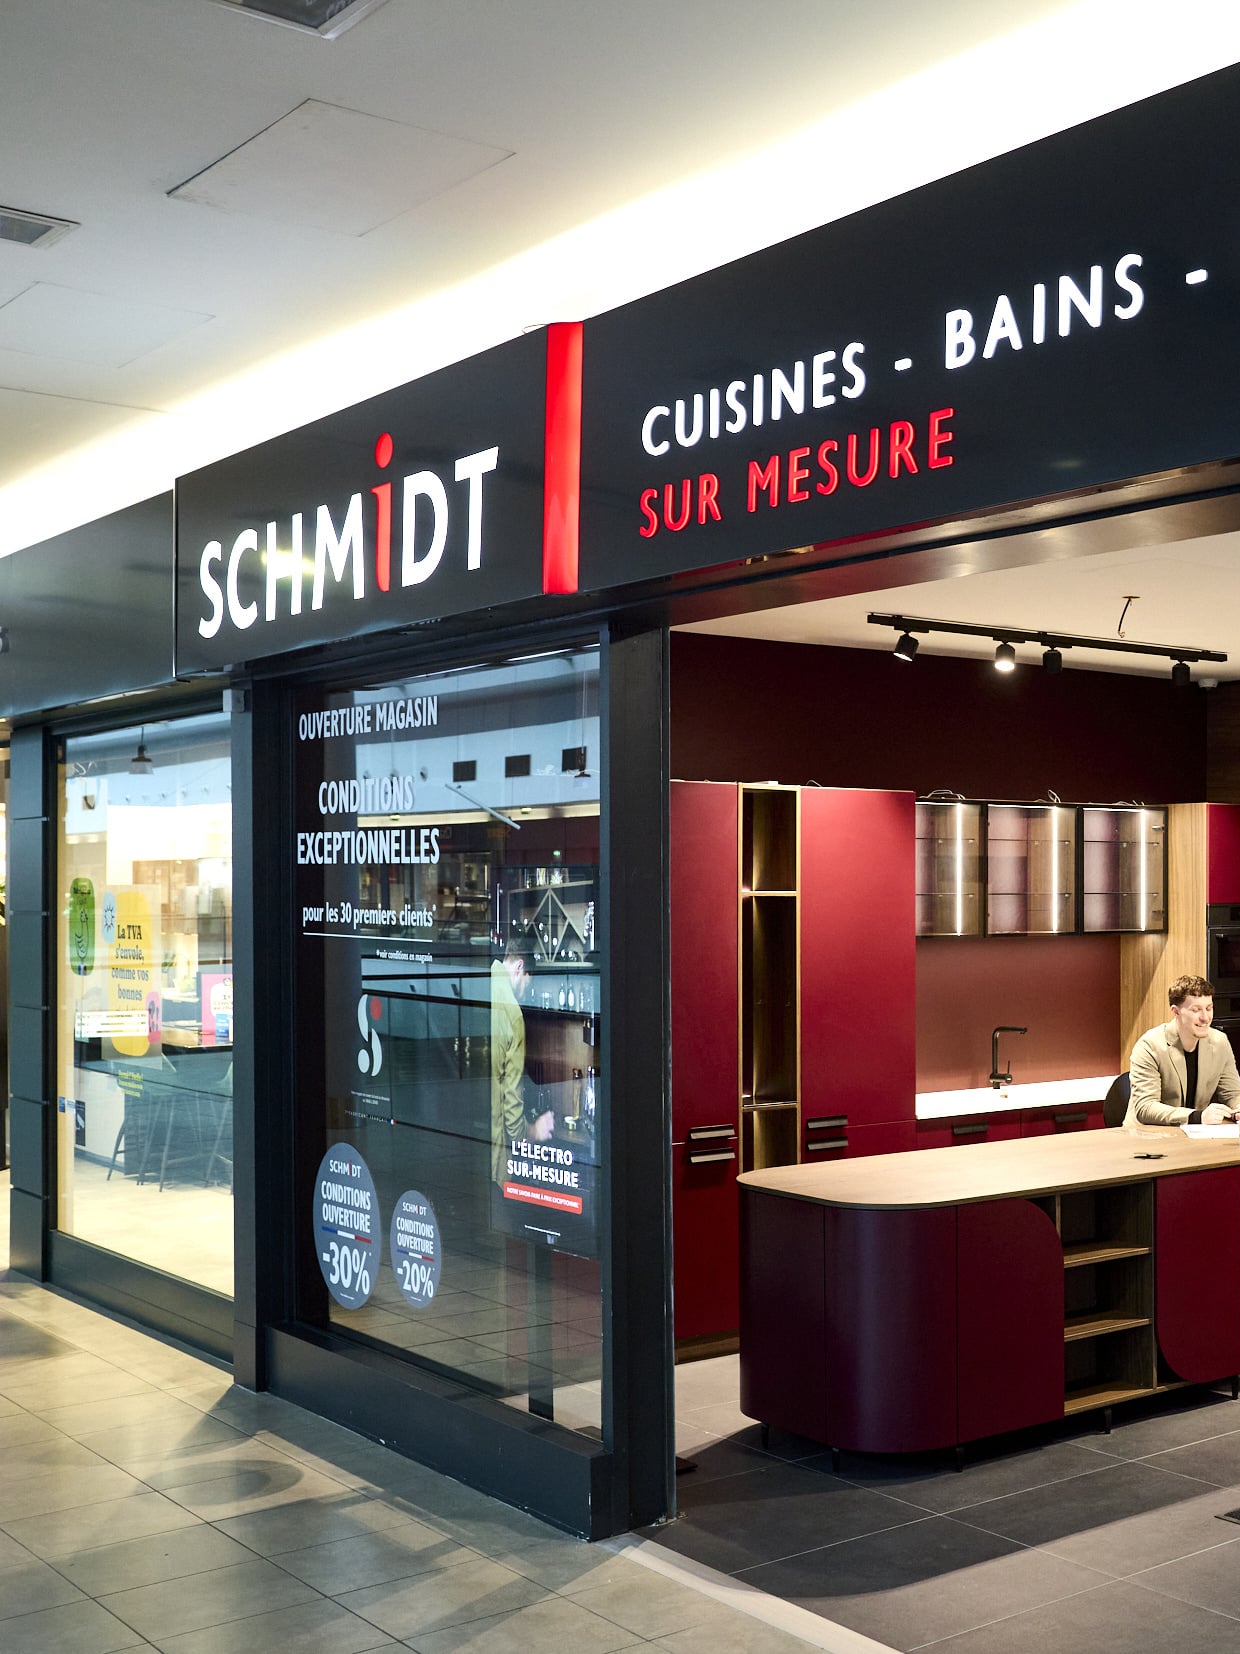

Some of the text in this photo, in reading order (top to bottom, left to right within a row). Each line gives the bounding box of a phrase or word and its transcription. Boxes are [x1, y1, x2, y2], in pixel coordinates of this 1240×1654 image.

[641, 342, 866, 457] CUISINES
[944, 253, 1144, 370] BAINS
[639, 407, 955, 539] SUR MESURE
[299, 695, 438, 741] OUVERTURE MAGASIN
[318, 775, 415, 815] CONDITIONS
[297, 827, 441, 865] EXCEPTIONNELLES
[302, 906, 324, 927] pour
[325, 901, 339, 923] les
[340, 902, 351, 923] 30
[353, 902, 397, 930] premiers
[117, 924, 143, 940] La TVA
[137, 968, 150, 981] vos
[511, 1139, 573, 1166] L'ÉLECTRO
[507, 1159, 579, 1189] SUR-MESURE
[321, 1180, 371, 1211] CONDITIONS
[322, 1203, 371, 1234] OUVERTURE
[396, 1216, 434, 1239] CONDITIONS
[397, 1232, 434, 1255] OUVERTURE
